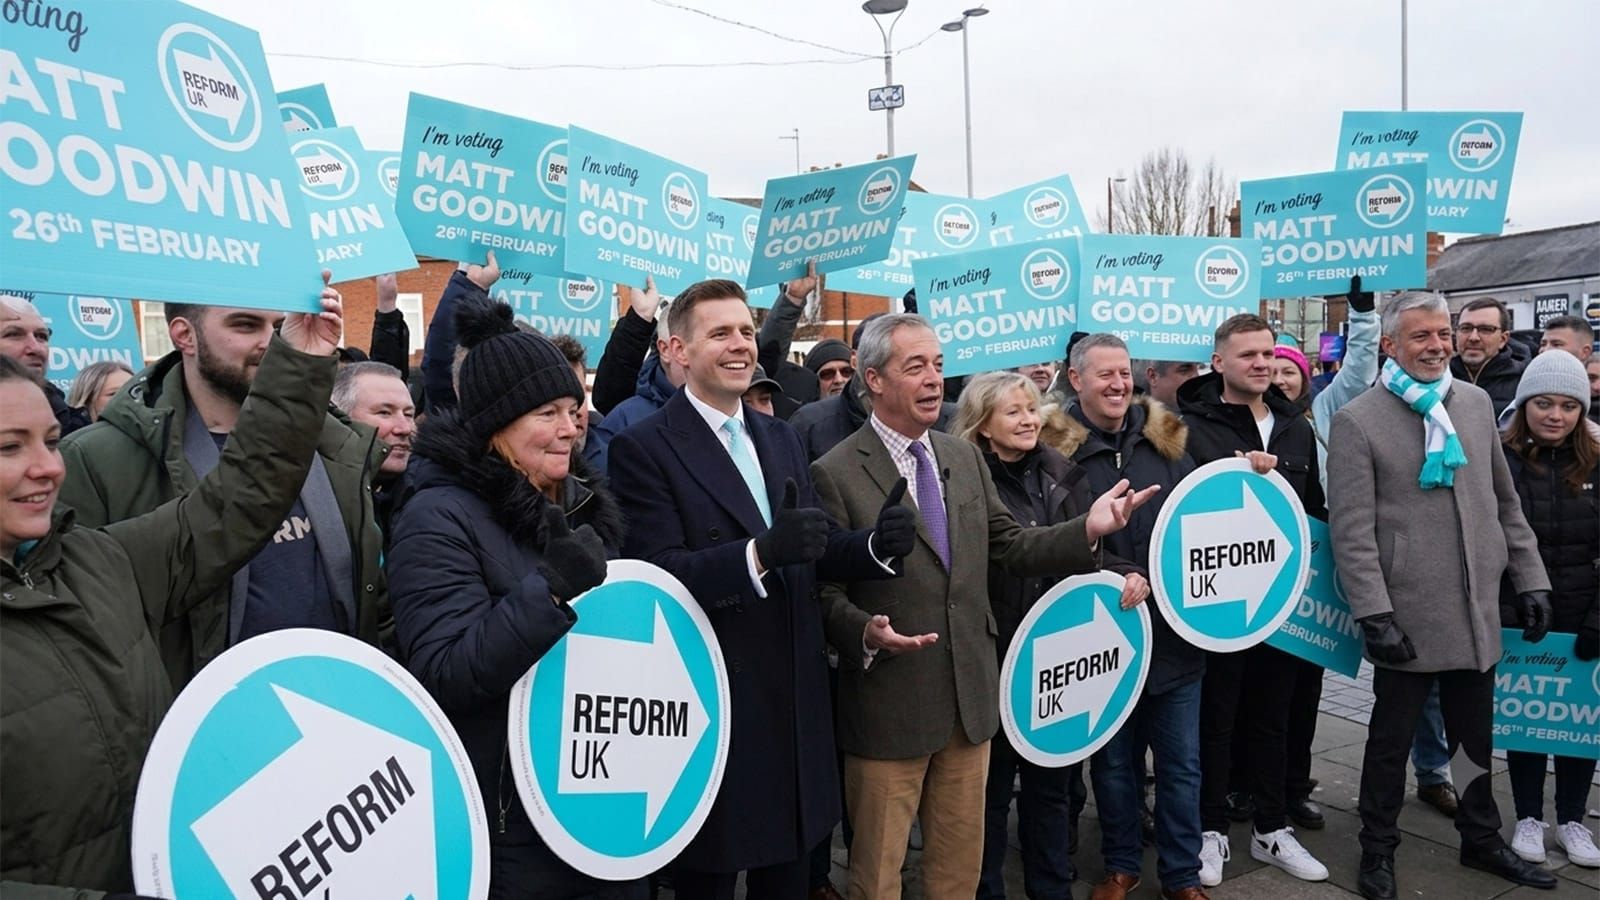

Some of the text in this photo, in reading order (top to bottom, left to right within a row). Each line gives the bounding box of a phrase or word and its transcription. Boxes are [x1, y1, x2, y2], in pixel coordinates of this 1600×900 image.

[0, 48, 126, 131] ATT
[183, 70, 239, 101] REFORM
[422, 126, 504, 158] I'm voting
[1351, 131, 1375, 146] I'm
[0, 121, 292, 229] OODWIN
[416, 151, 515, 194] MATT
[582, 156, 601, 174] I'm
[604, 162, 640, 187] voting
[1347, 151, 1429, 170] MATT
[413, 184, 567, 238] GOODWI
[579, 179, 648, 220] MATT
[1255, 193, 1323, 216] I'm voting
[9, 207, 261, 267] 26th FEBRUARY
[578, 210, 699, 264] GOODWIN
[767, 206, 842, 237] MATT
[1253, 214, 1337, 241] MATT
[471, 230, 558, 257] FEBRUARY
[764, 217, 891, 259] GOODWIN
[622, 254, 682, 280] FEBRUARY
[804, 244, 867, 265] FEBRUARY
[1096, 252, 1164, 271] I'm voting
[929, 266, 992, 294] I'm voting
[1092, 275, 1175, 298] MATT
[1307, 265, 1389, 281] FEBRUARY
[929, 288, 1007, 319] MATT
[934, 304, 1077, 344] GOODWIN
[1143, 332, 1215, 346] FEBRUAR
[985, 334, 1057, 356] FEBRUARY
[1189, 539, 1276, 572] REFORM
[1190, 573, 1217, 598] UK
[1039, 647, 1120, 694] REFORM
[1525, 652, 1568, 672] voting
[1494, 673, 1572, 697] MATT
[572, 693, 689, 738] REFORM
[1038, 691, 1064, 719] UK
[571, 739, 610, 780] UK
[250, 755, 416, 900] REFORM
